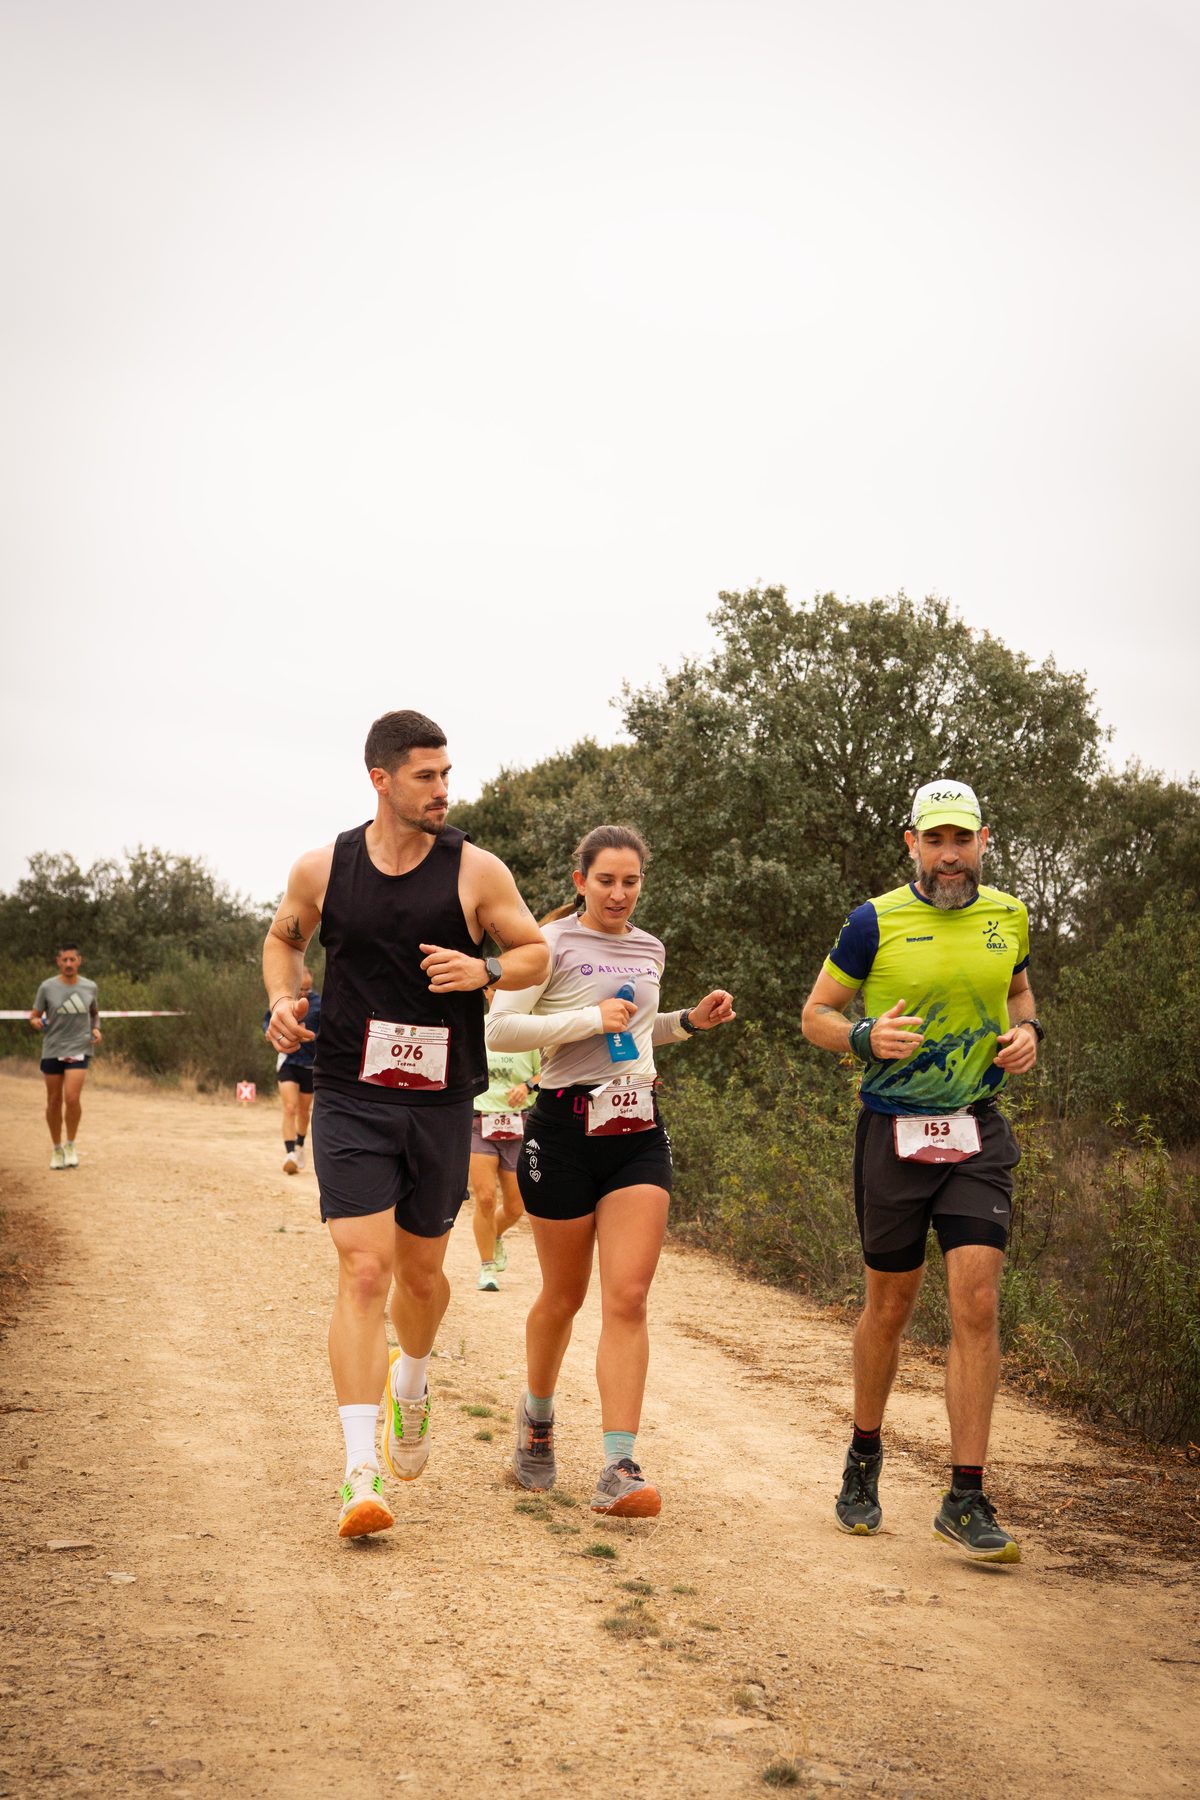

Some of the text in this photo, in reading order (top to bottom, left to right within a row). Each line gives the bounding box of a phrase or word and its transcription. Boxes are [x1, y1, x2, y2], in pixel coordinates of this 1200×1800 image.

[598, 964, 642, 974] ABILITY
[390, 1044, 423, 1060] 076
[501, 1056, 514, 1064] 10K
[611, 1091, 638, 1107] 022
[494, 1118, 511, 1126] 083
[924, 1122, 951, 1136] 153
